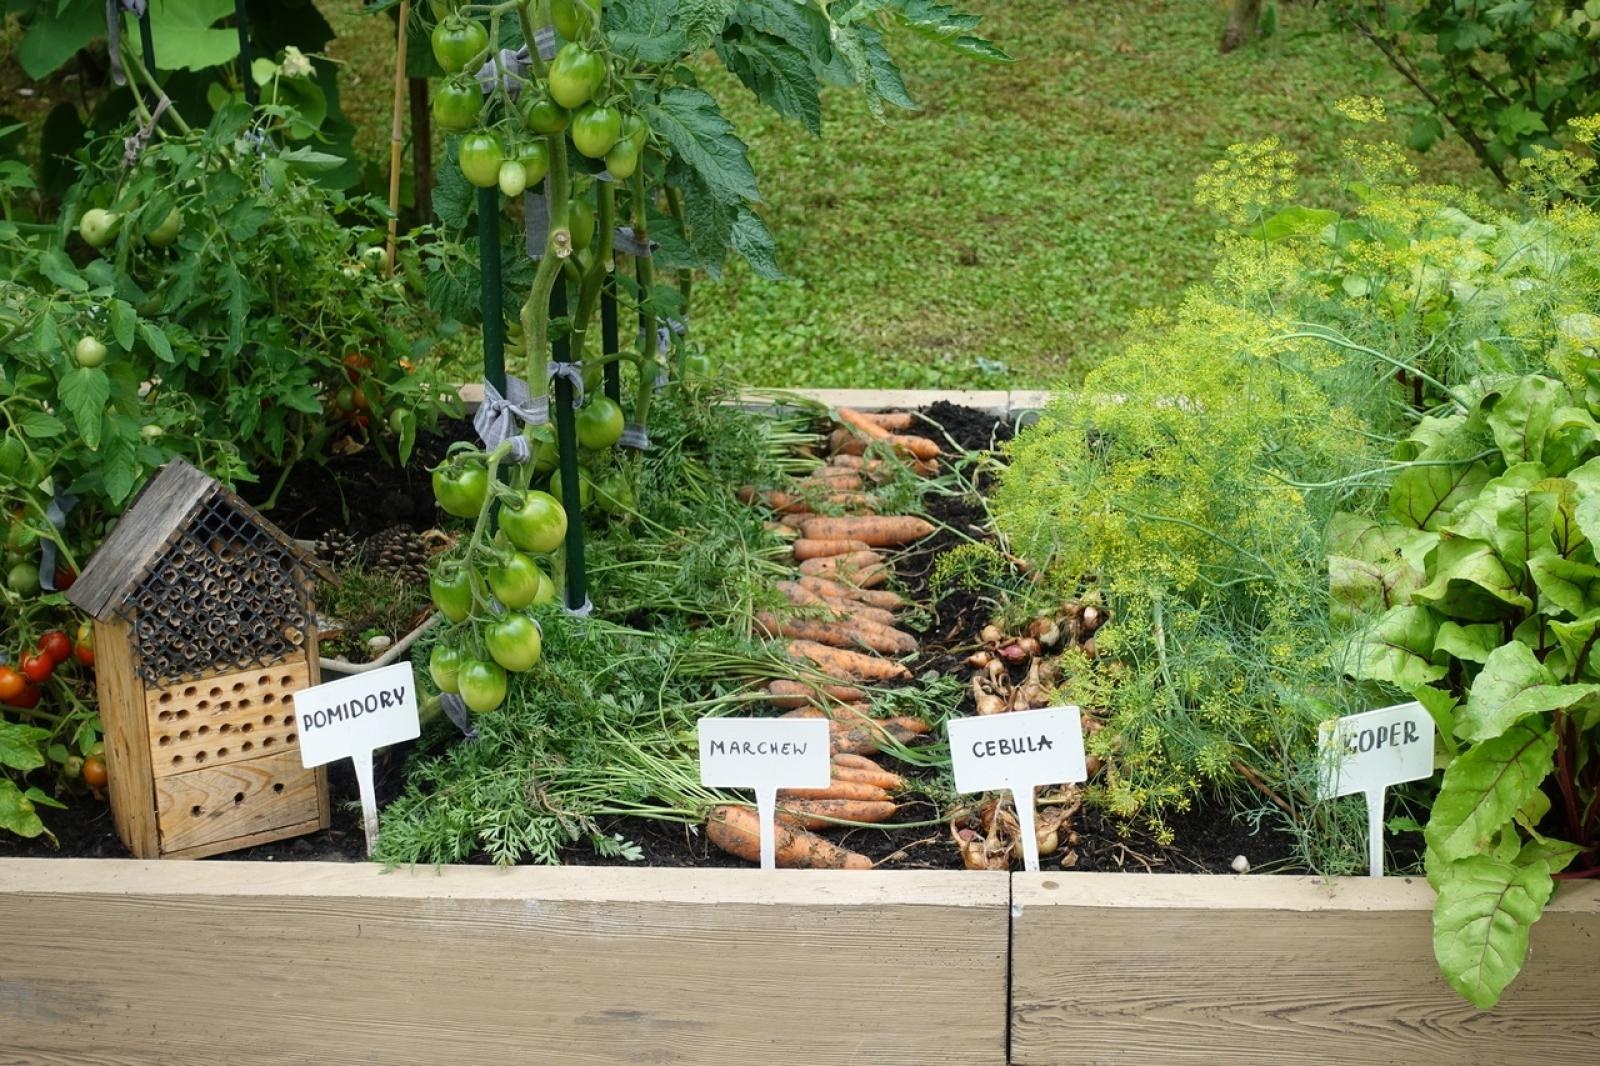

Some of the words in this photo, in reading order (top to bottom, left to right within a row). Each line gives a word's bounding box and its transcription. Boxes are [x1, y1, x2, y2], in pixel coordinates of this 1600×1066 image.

[303, 686, 405, 732] POMIDORY
[710, 740, 807, 756] MARCHEW
[972, 735, 1053, 757] CEBULA
